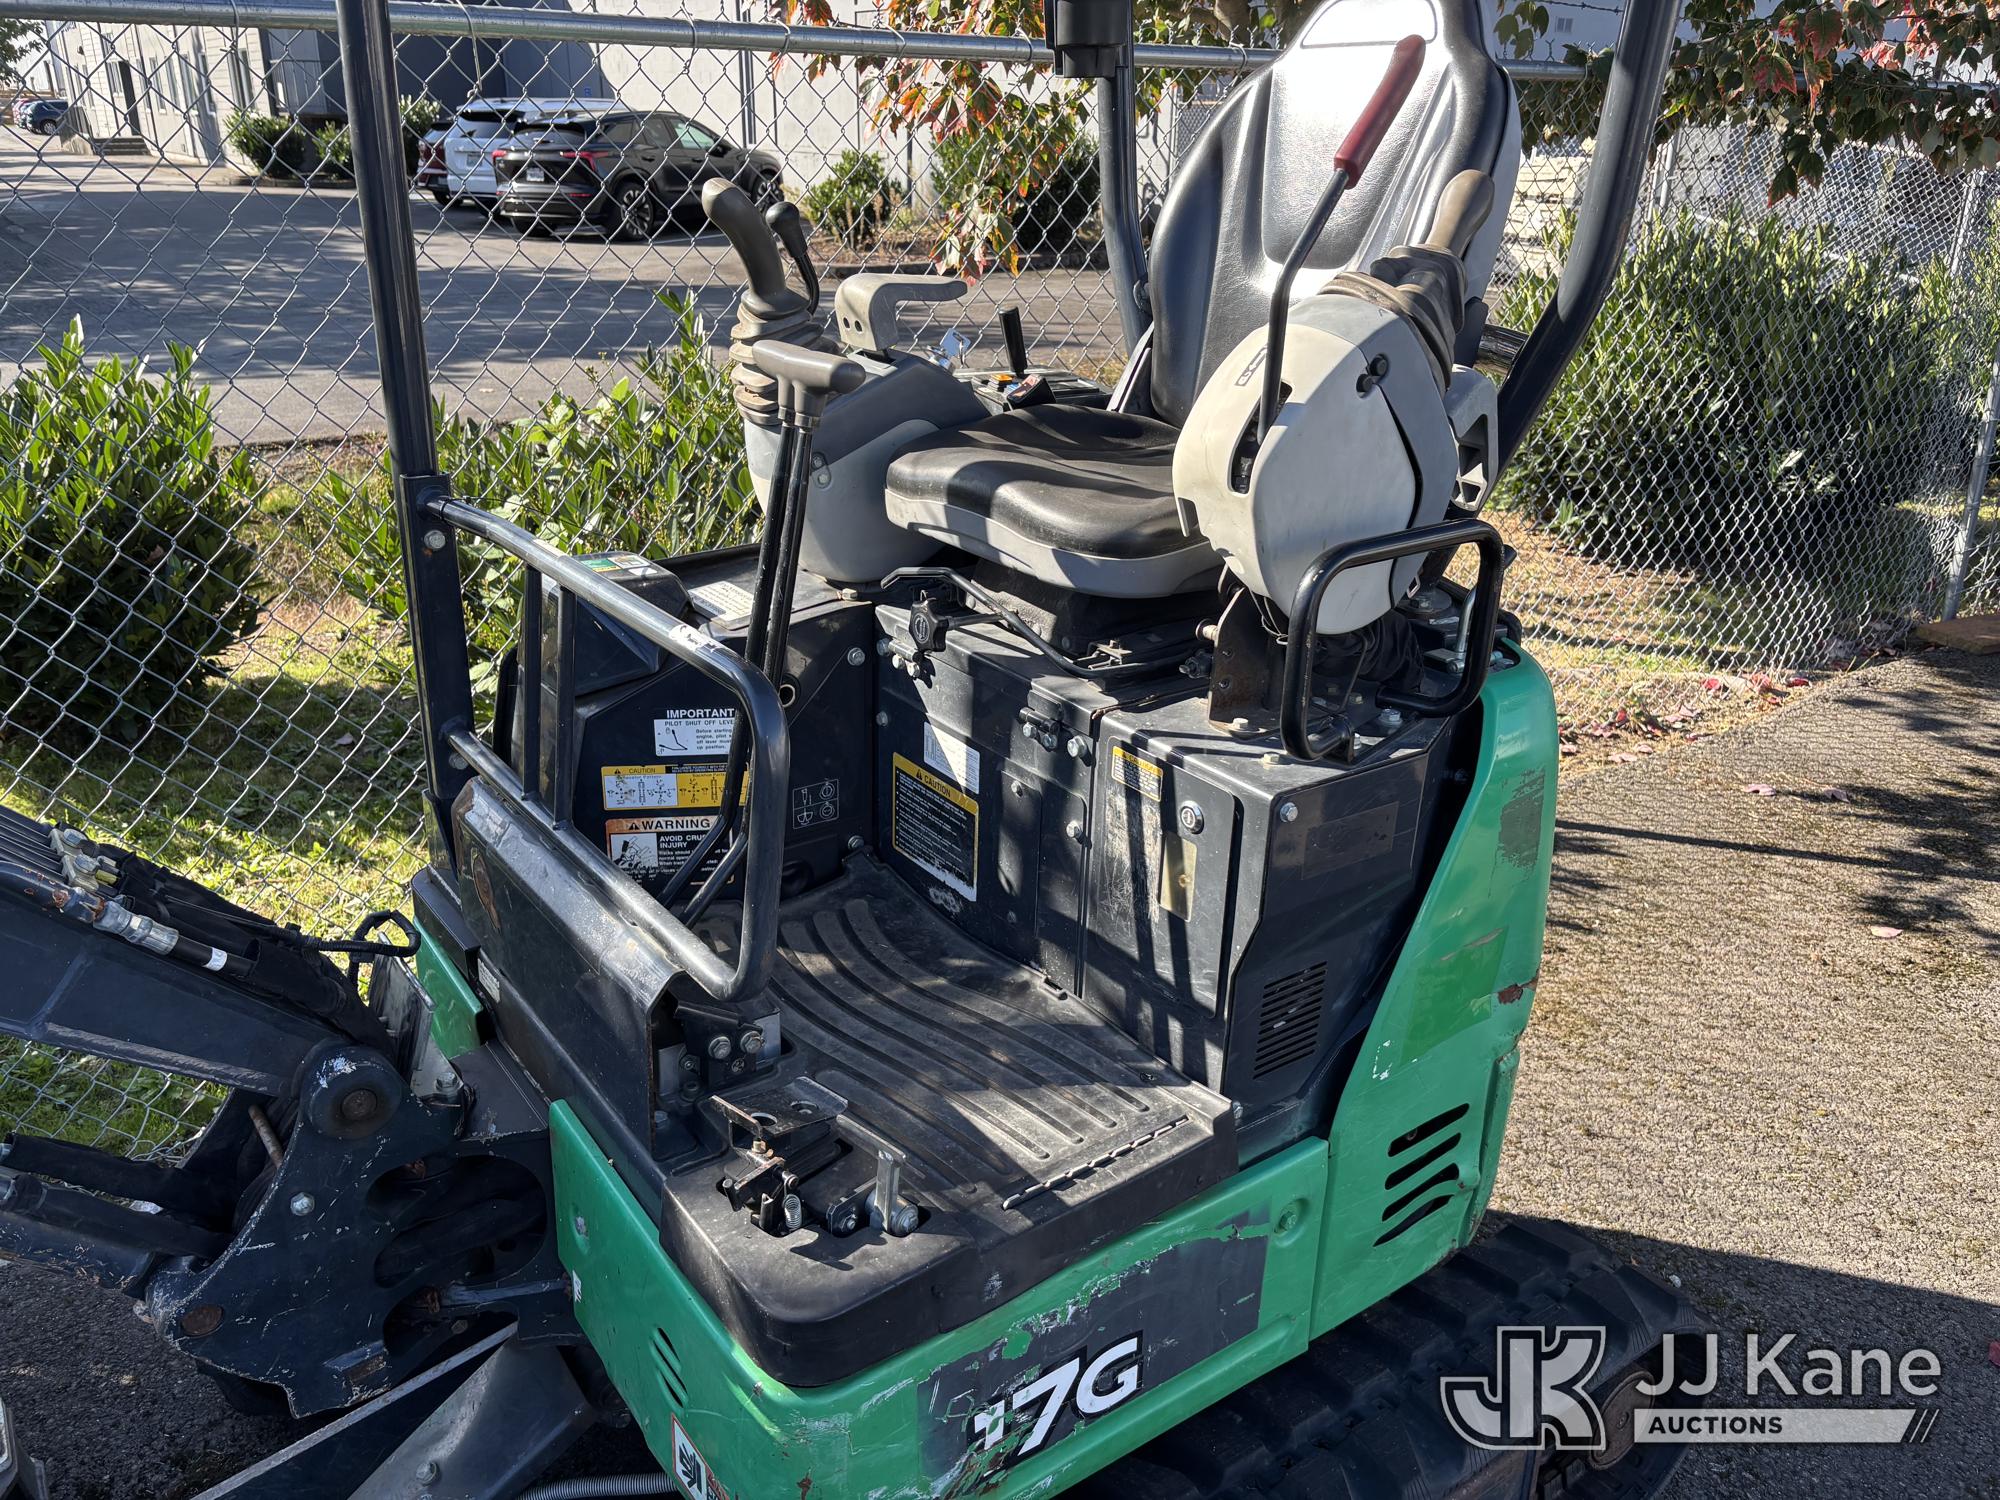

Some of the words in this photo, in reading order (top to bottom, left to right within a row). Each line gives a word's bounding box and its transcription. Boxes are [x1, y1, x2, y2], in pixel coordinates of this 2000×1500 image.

[666, 708, 735, 719] IMPORTANT
[924, 774, 951, 798] CAUTION
[641, 818, 710, 830] WARNING
[659, 834, 683, 842] AVOID
[659, 841, 688, 849] INJURY
[974, 1337, 1139, 1477] 17G
